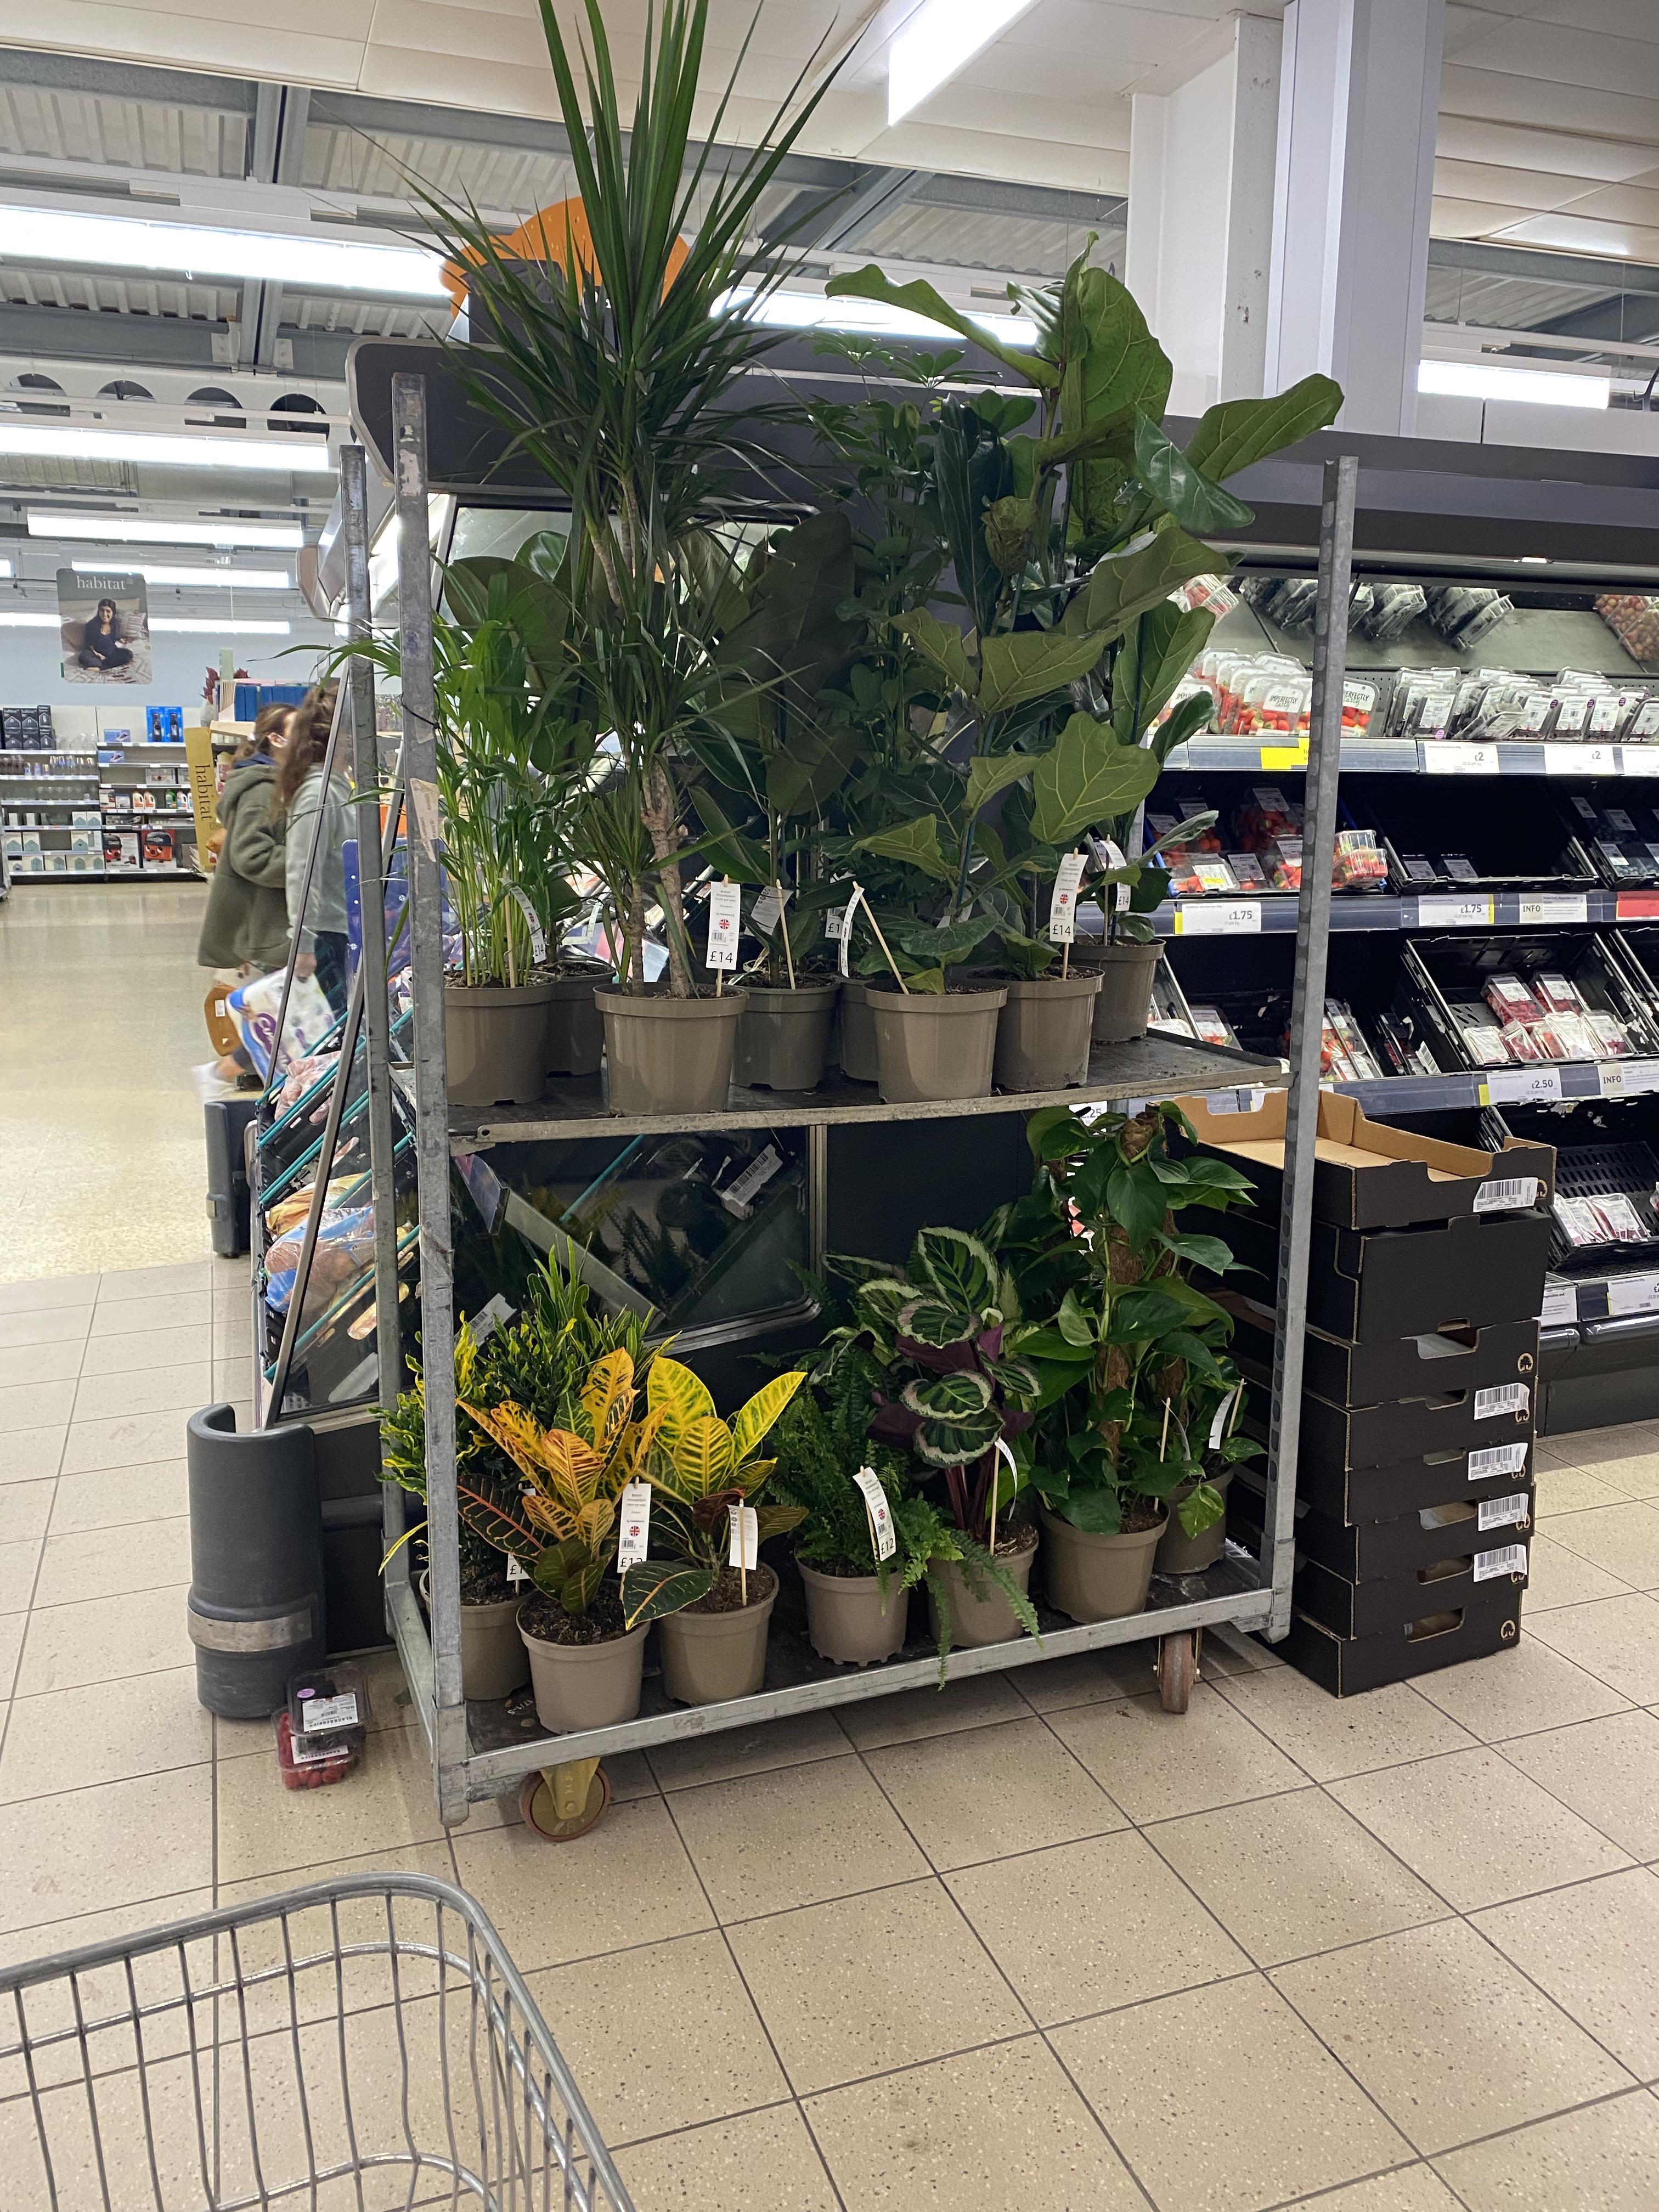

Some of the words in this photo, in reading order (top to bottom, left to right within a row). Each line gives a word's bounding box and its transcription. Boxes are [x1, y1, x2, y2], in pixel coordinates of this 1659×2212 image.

[76, 575, 126, 590] habitat
[1345, 691, 1369, 701] ERFECTLY
[1475, 752, 1484, 761] £2
[1592, 751, 1601, 760] £2
[195, 764, 213, 821] habitat
[1118, 895, 1129, 905] £14
[1460, 904, 1482, 913] £1.75
[1229, 910, 1252, 919] £1.75
[828, 923, 840, 933] £1
[1053, 924, 1071, 936] £14
[535, 944, 544, 956] £14
[710, 951, 733, 963] £14
[1532, 1079, 1553, 1089] £2.50
[1603, 1075, 1622, 1084] INFO
[881, 1538, 894, 1555] £12
